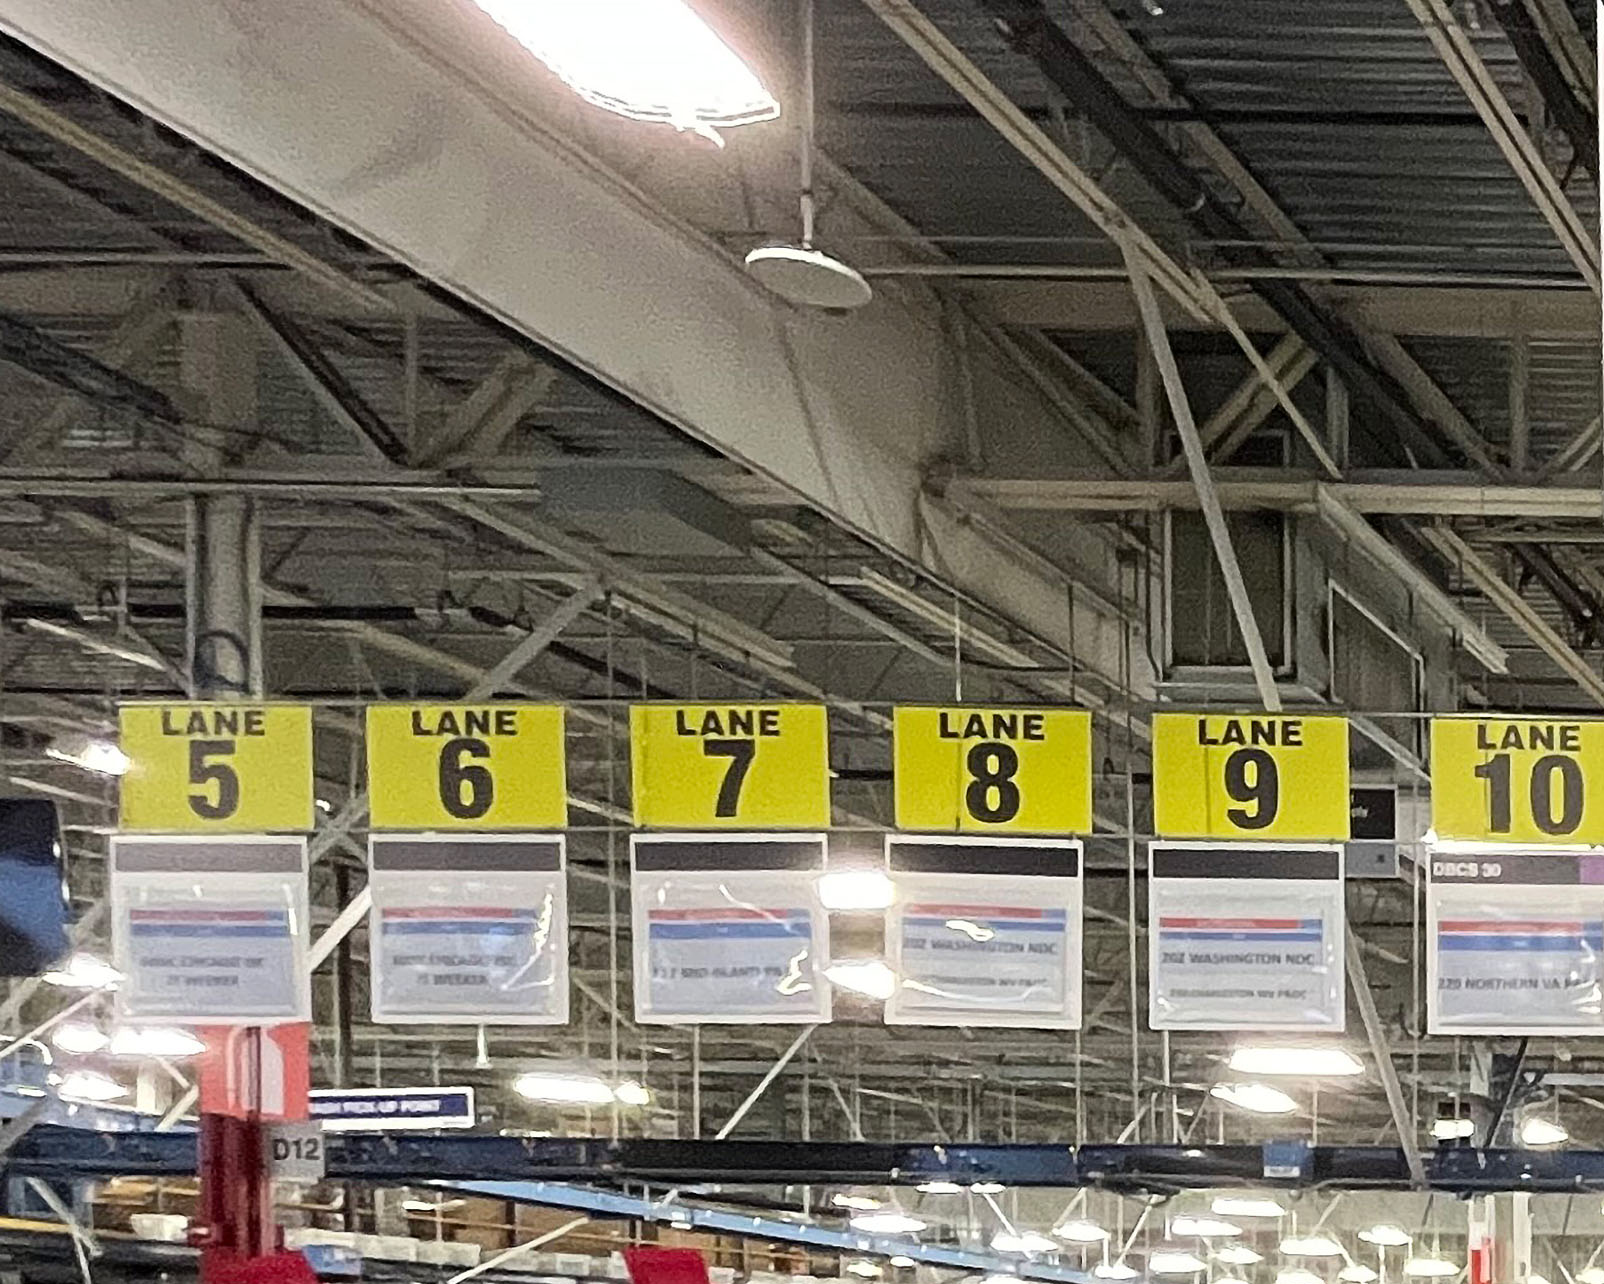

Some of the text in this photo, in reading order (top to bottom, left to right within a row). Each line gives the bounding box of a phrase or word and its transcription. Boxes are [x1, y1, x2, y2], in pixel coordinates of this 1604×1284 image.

[162, 710, 265, 736] LANE
[413, 710, 518, 736] LANE
[676, 709, 780, 736] LANE
[939, 712, 1045, 740] LANE
[1198, 719, 1303, 746] LANE
[1477, 724, 1580, 751] LANE
[189, 740, 239, 819] 5
[439, 737, 493, 820] 6
[703, 738, 756, 818] 7
[966, 741, 1020, 823] 8
[1224, 747, 1279, 829] 9
[1474, 753, 1583, 832] 10
[1189, 952, 1281, 965] WASHINGTON
[1286, 953, 1315, 965] NDC
[1465, 978, 1538, 990] NORTHERN
[1543, 978, 1561, 989] VA
[271, 1138, 321, 1161] D12
